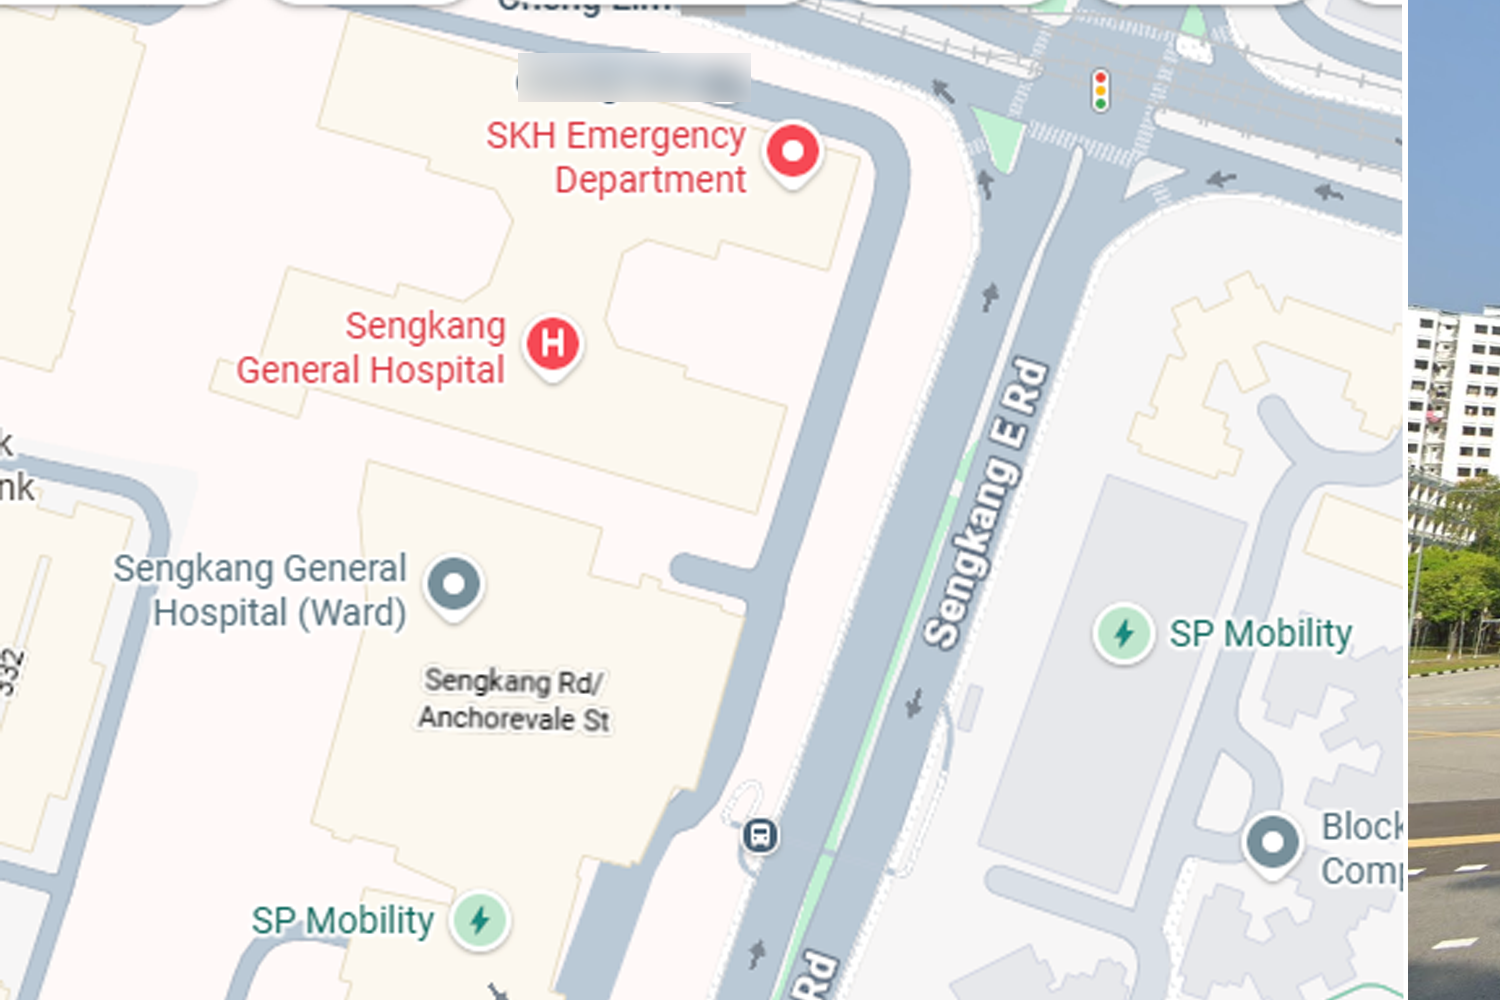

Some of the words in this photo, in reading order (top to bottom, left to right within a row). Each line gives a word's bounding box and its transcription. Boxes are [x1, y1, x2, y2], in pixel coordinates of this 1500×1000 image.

[487, 122, 555, 149] SKH
[568, 122, 746, 157] Emergency
[556, 165, 747, 200] Department
[346, 310, 505, 346] Sengkang
[237, 354, 359, 384] General
[371, 354, 504, 390] Hospital
[1001, 356, 1049, 416] Rd
[989, 416, 1028, 449] E
[114, 552, 274, 590] Sengkang
[284, 552, 406, 582] General
[923, 455, 1021, 651] Sengkang
[155, 597, 286, 633] Hospital
[299, 597, 406, 633] (Ward)
[1170, 620, 1214, 646] SP
[1225, 618, 1353, 655] Mobility
[425, 667, 551, 698] Sengkang
[559, 668, 603, 696] Rd/
[418, 706, 575, 731] Anchorevale
[584, 708, 609, 732] St
[1323, 810, 1404, 840] Block
[252, 907, 295, 933] SP
[307, 905, 434, 941] Mobility
